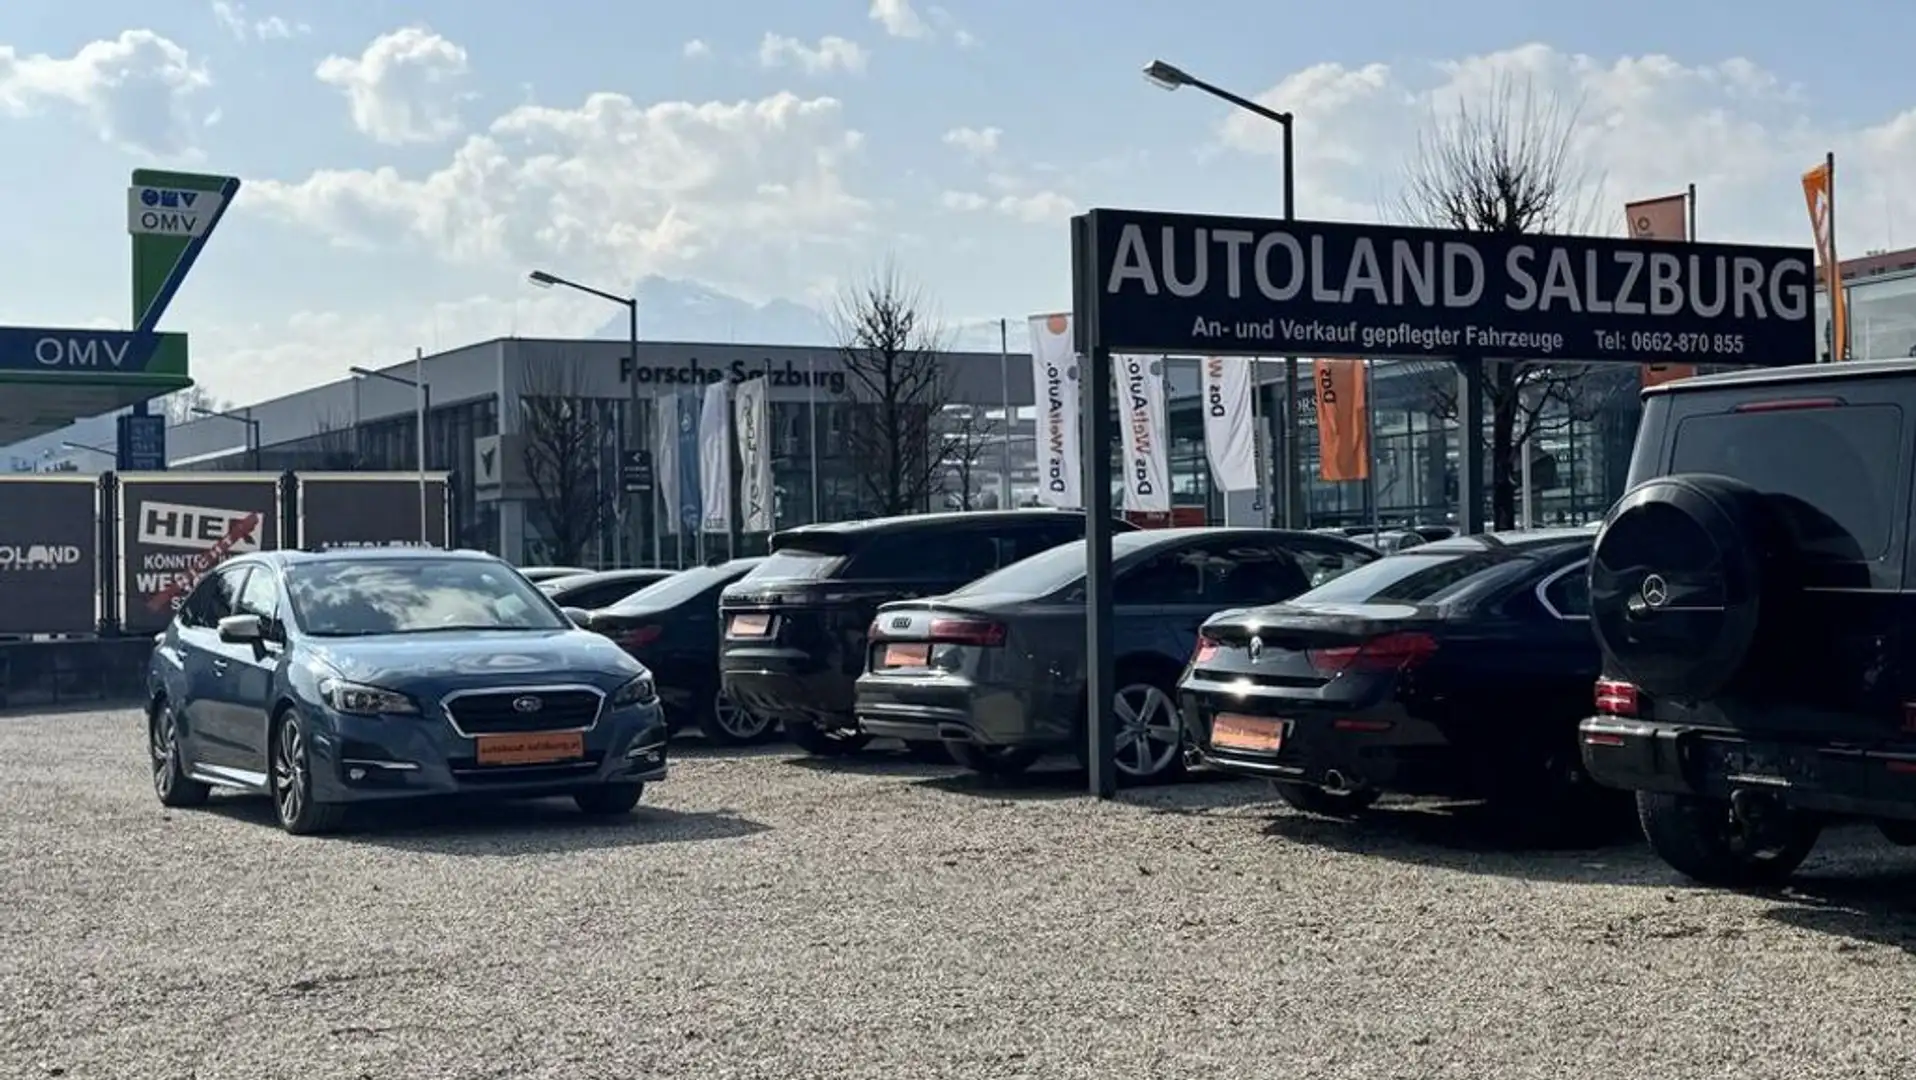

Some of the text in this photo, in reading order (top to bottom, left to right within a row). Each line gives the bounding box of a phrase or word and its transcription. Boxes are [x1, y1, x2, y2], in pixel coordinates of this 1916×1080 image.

[141, 211, 197, 232] OMV
[1107, 223, 1808, 321] AUTOLAND SALZBURG
[1191, 316, 1564, 353] An- und Verkauf gepflegter Fahrzeuge
[1594, 330, 1744, 353] Tel: 0662-870 855
[35, 337, 131, 366] OMV
